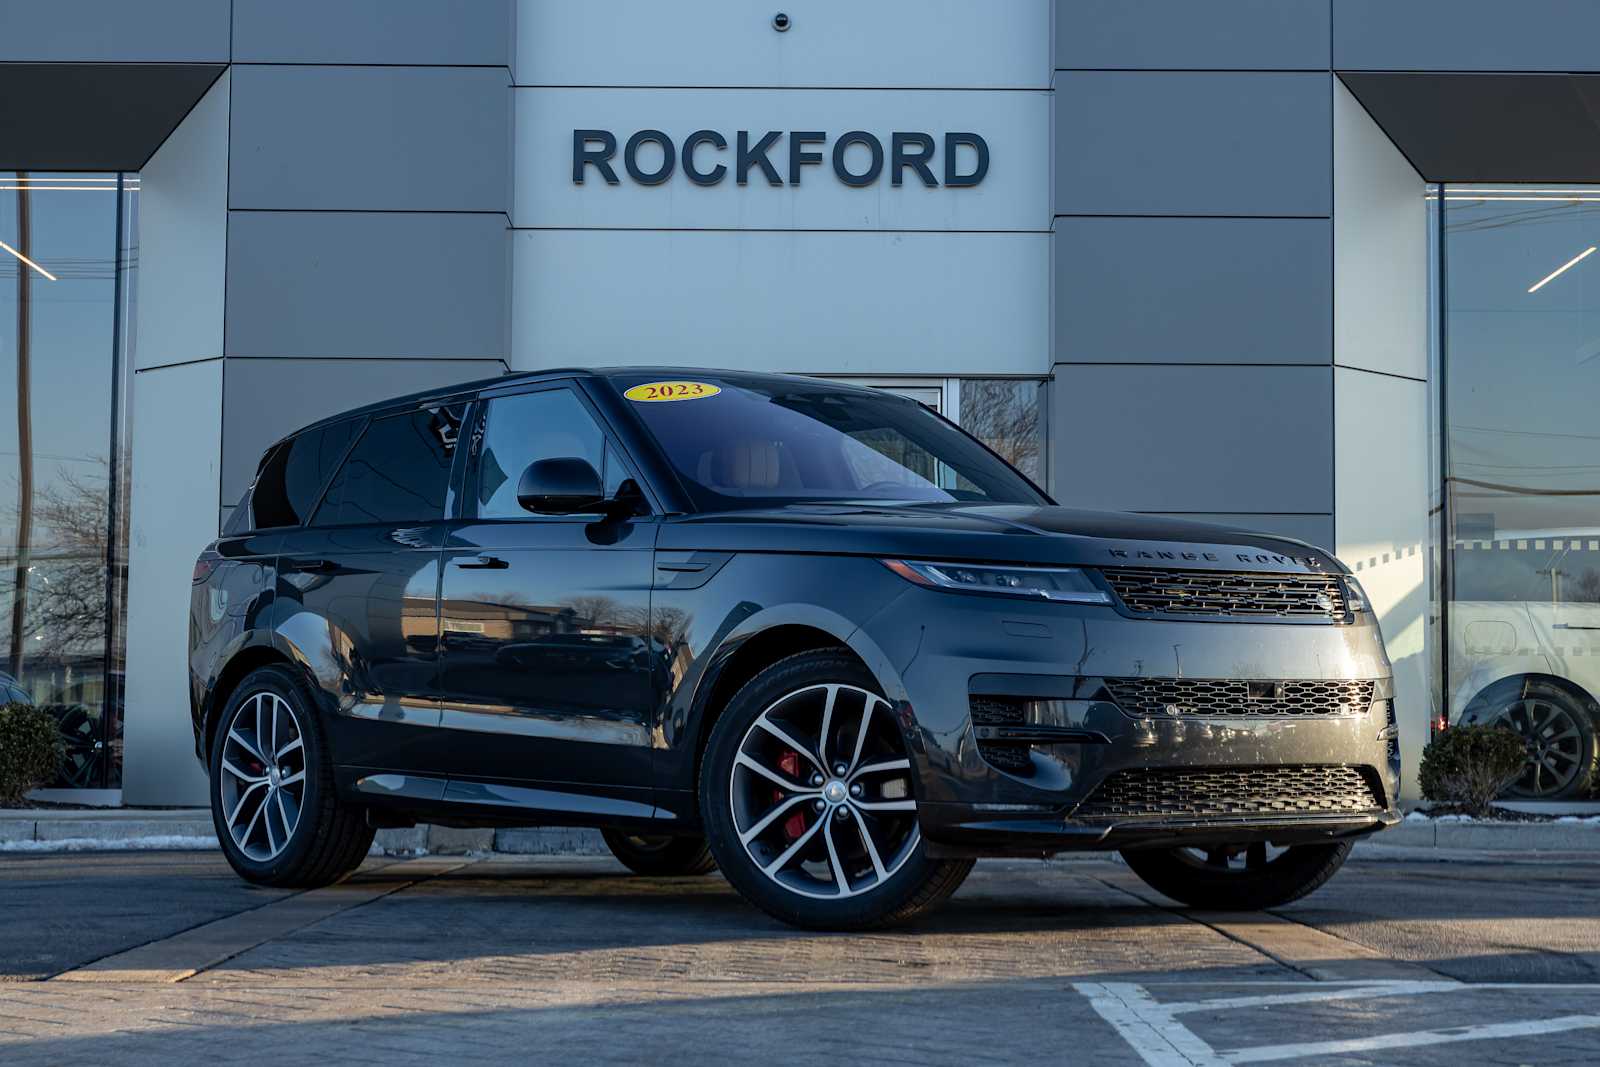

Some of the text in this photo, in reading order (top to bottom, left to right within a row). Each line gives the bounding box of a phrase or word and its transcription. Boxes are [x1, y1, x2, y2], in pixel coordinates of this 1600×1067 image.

[572, 128, 990, 187] ROCKFORD
[645, 384, 703, 399] 2023
[1108, 549, 1218, 561] RANGE
